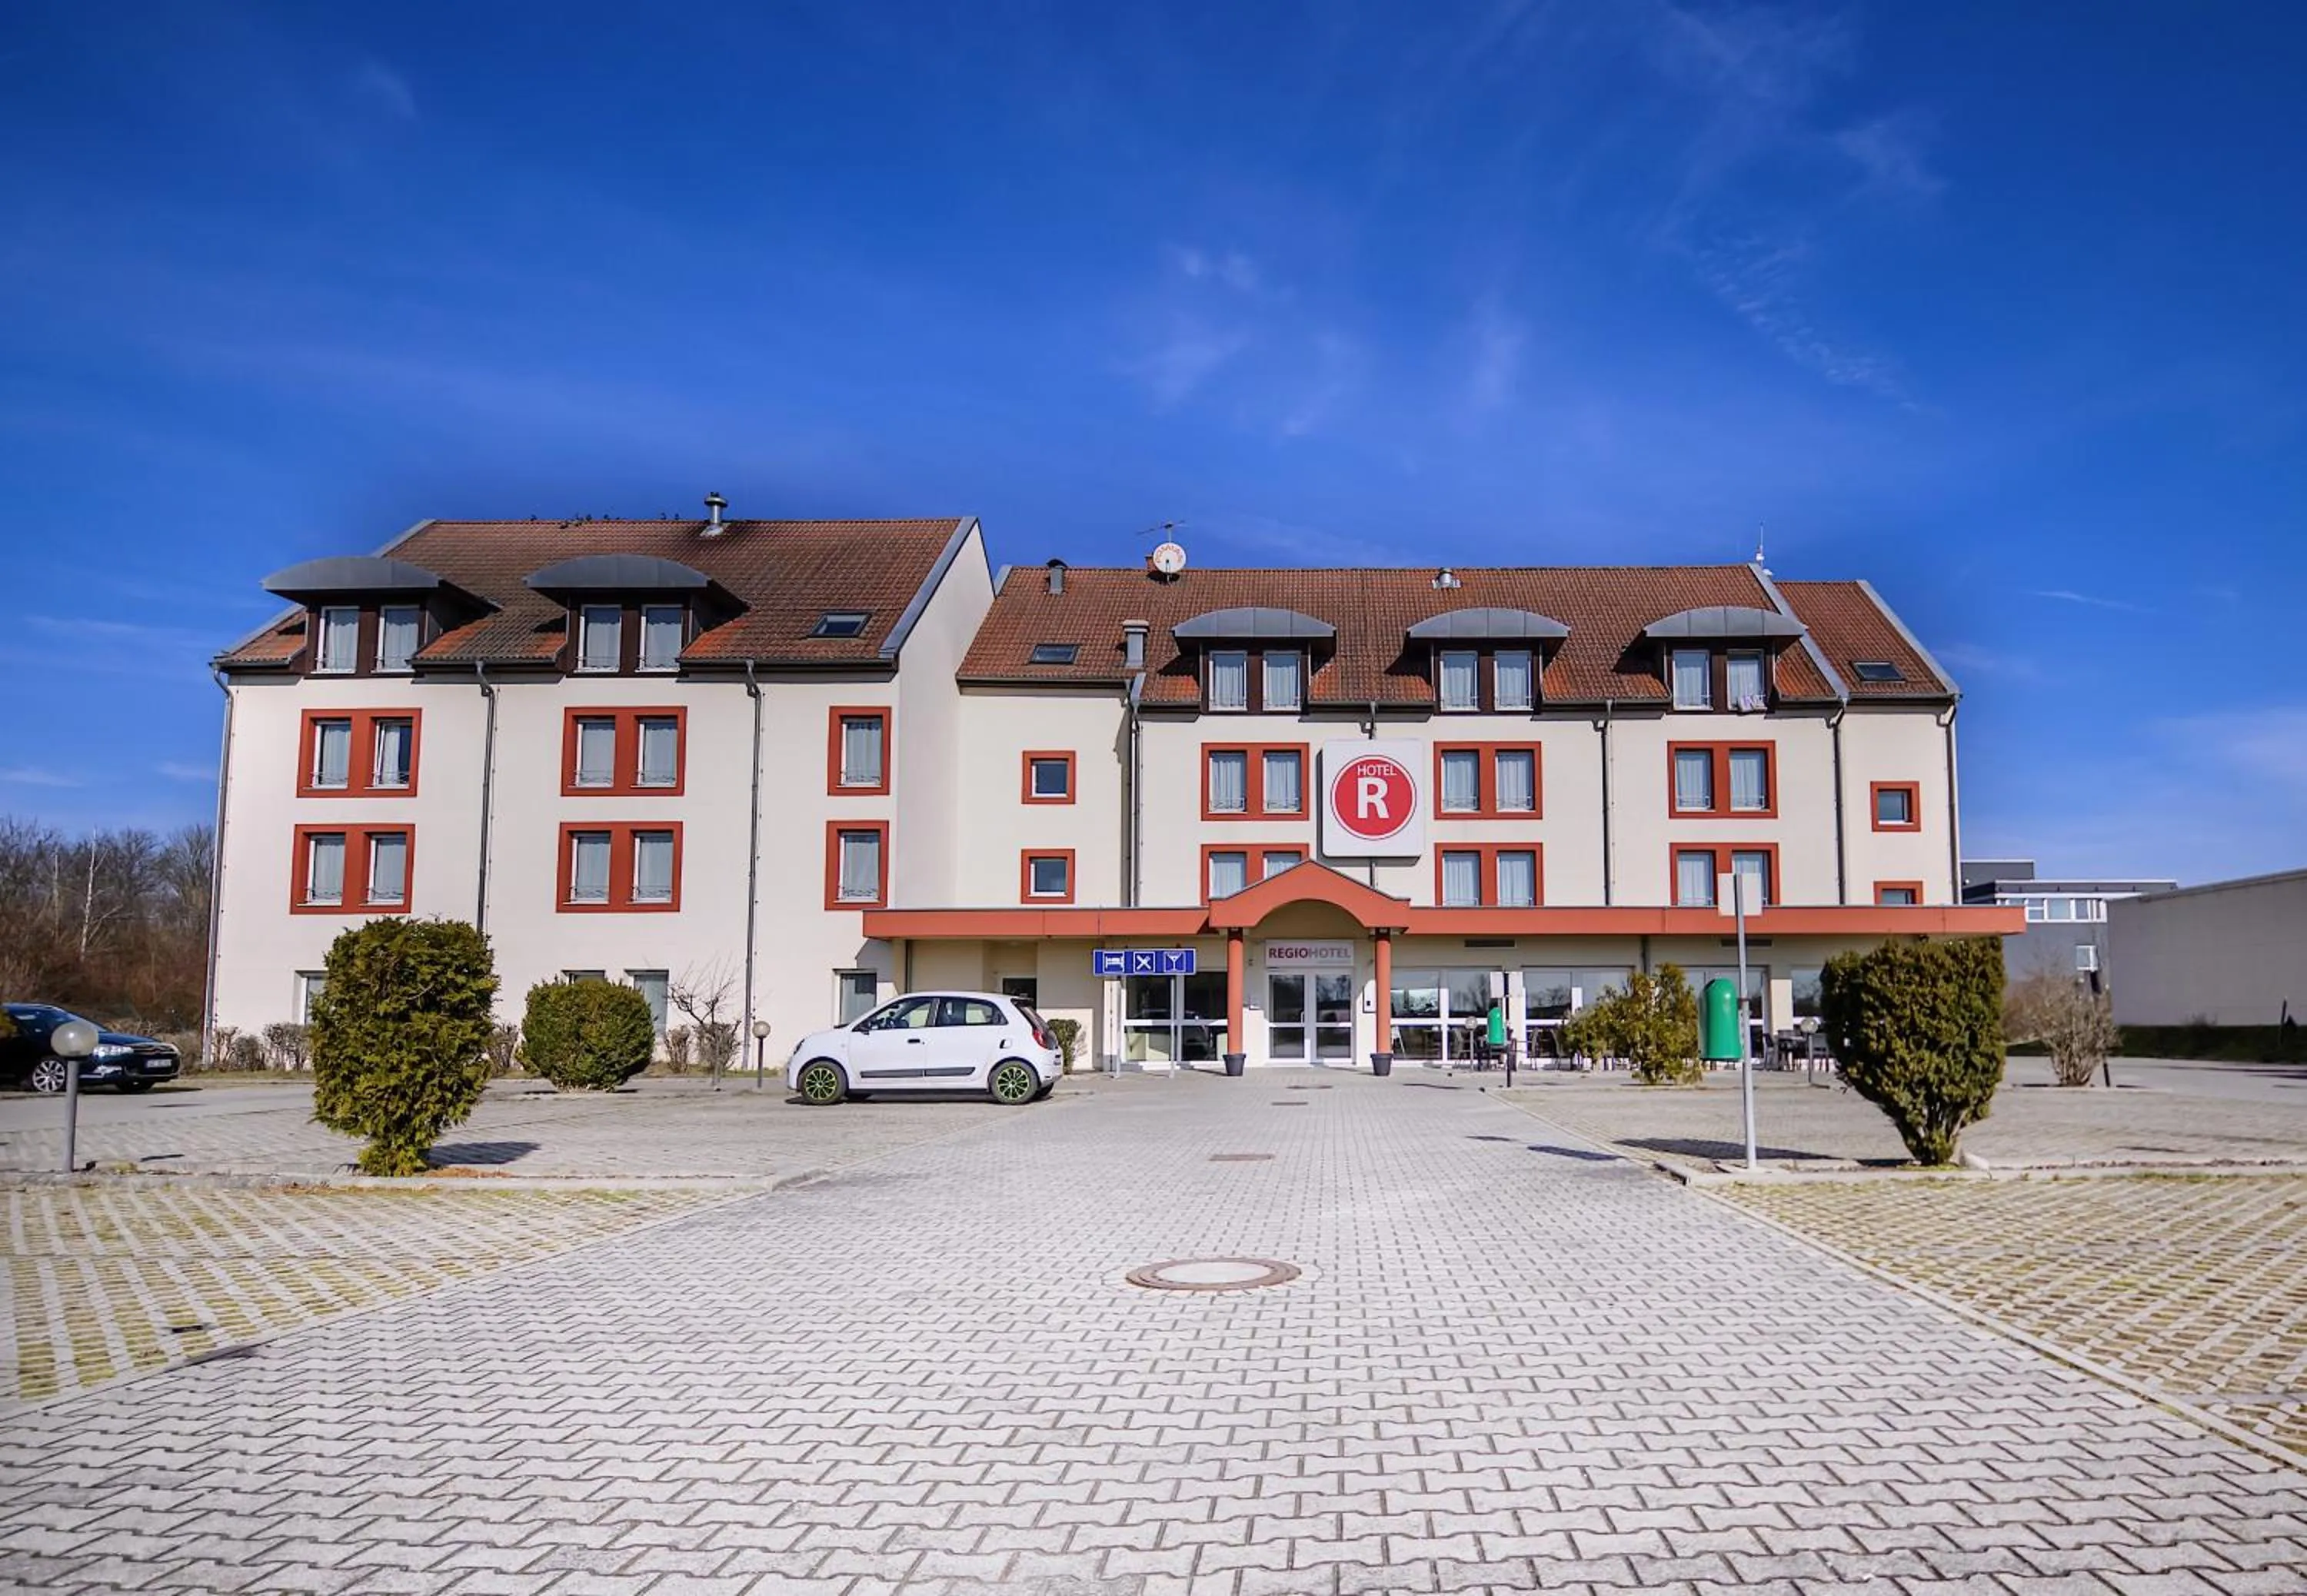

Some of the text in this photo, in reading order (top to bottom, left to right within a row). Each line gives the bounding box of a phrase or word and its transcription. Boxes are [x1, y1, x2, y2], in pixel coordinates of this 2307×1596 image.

[1357, 764, 1397, 776] HOTEL
[1357, 776, 1390, 819] R
[1268, 947, 1351, 959] REGIOHOTEL
